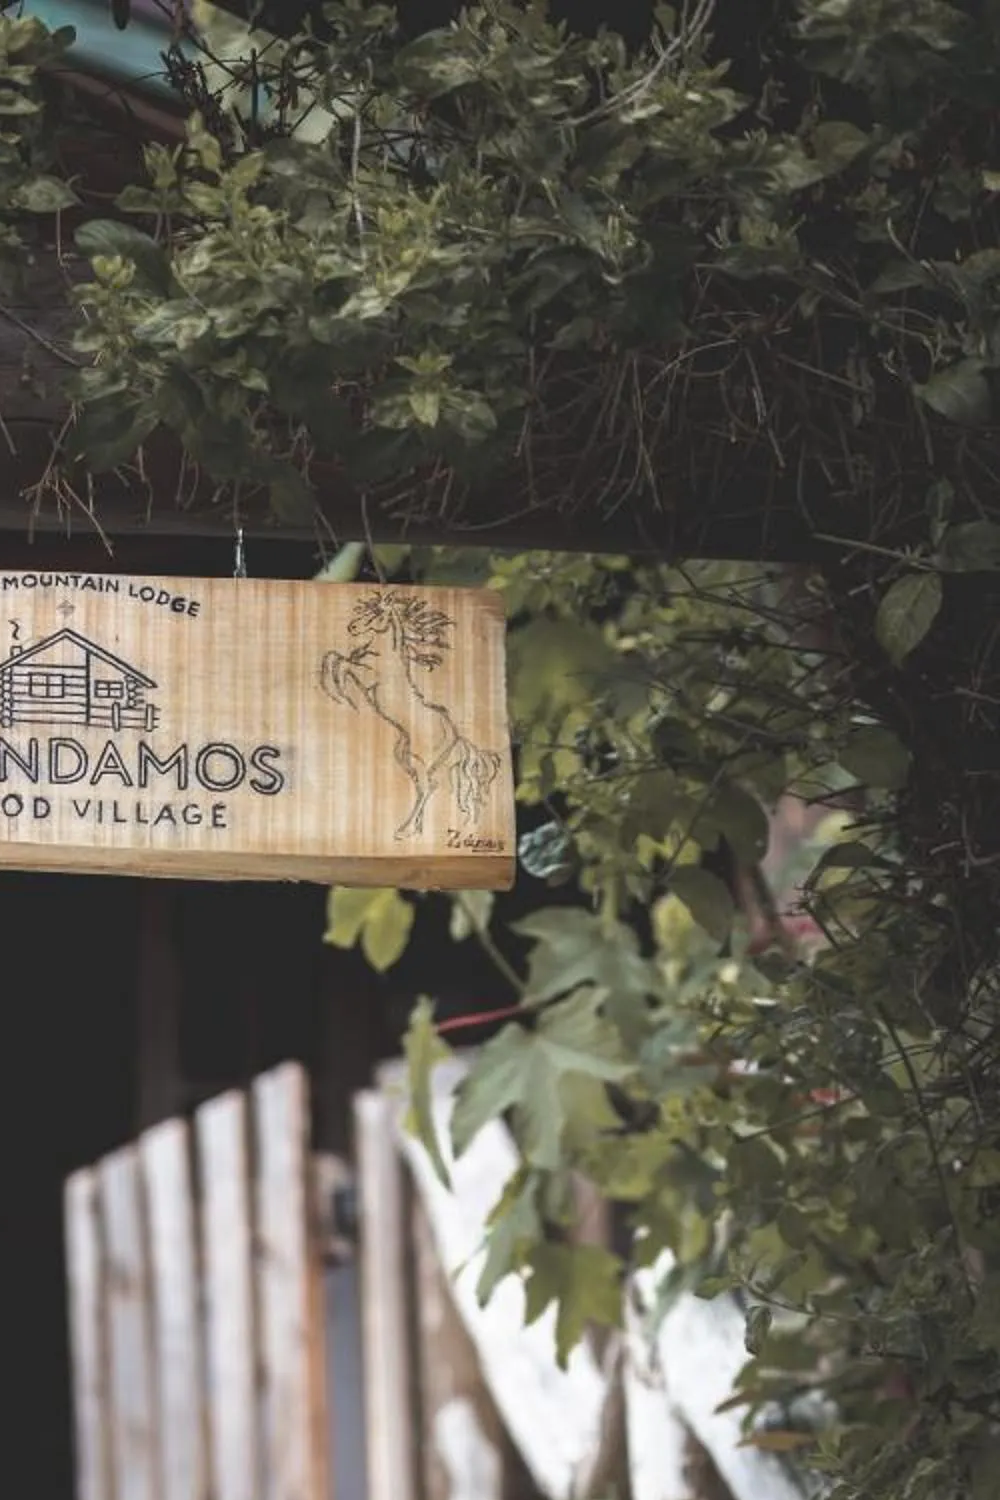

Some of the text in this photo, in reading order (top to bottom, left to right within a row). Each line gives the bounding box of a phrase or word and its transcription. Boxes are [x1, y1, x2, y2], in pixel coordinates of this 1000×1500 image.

[2, 573, 120, 593] MOUNTAIN
[128, 582, 202, 617] LODGE
[73, 799, 227, 829] VILLAGE
